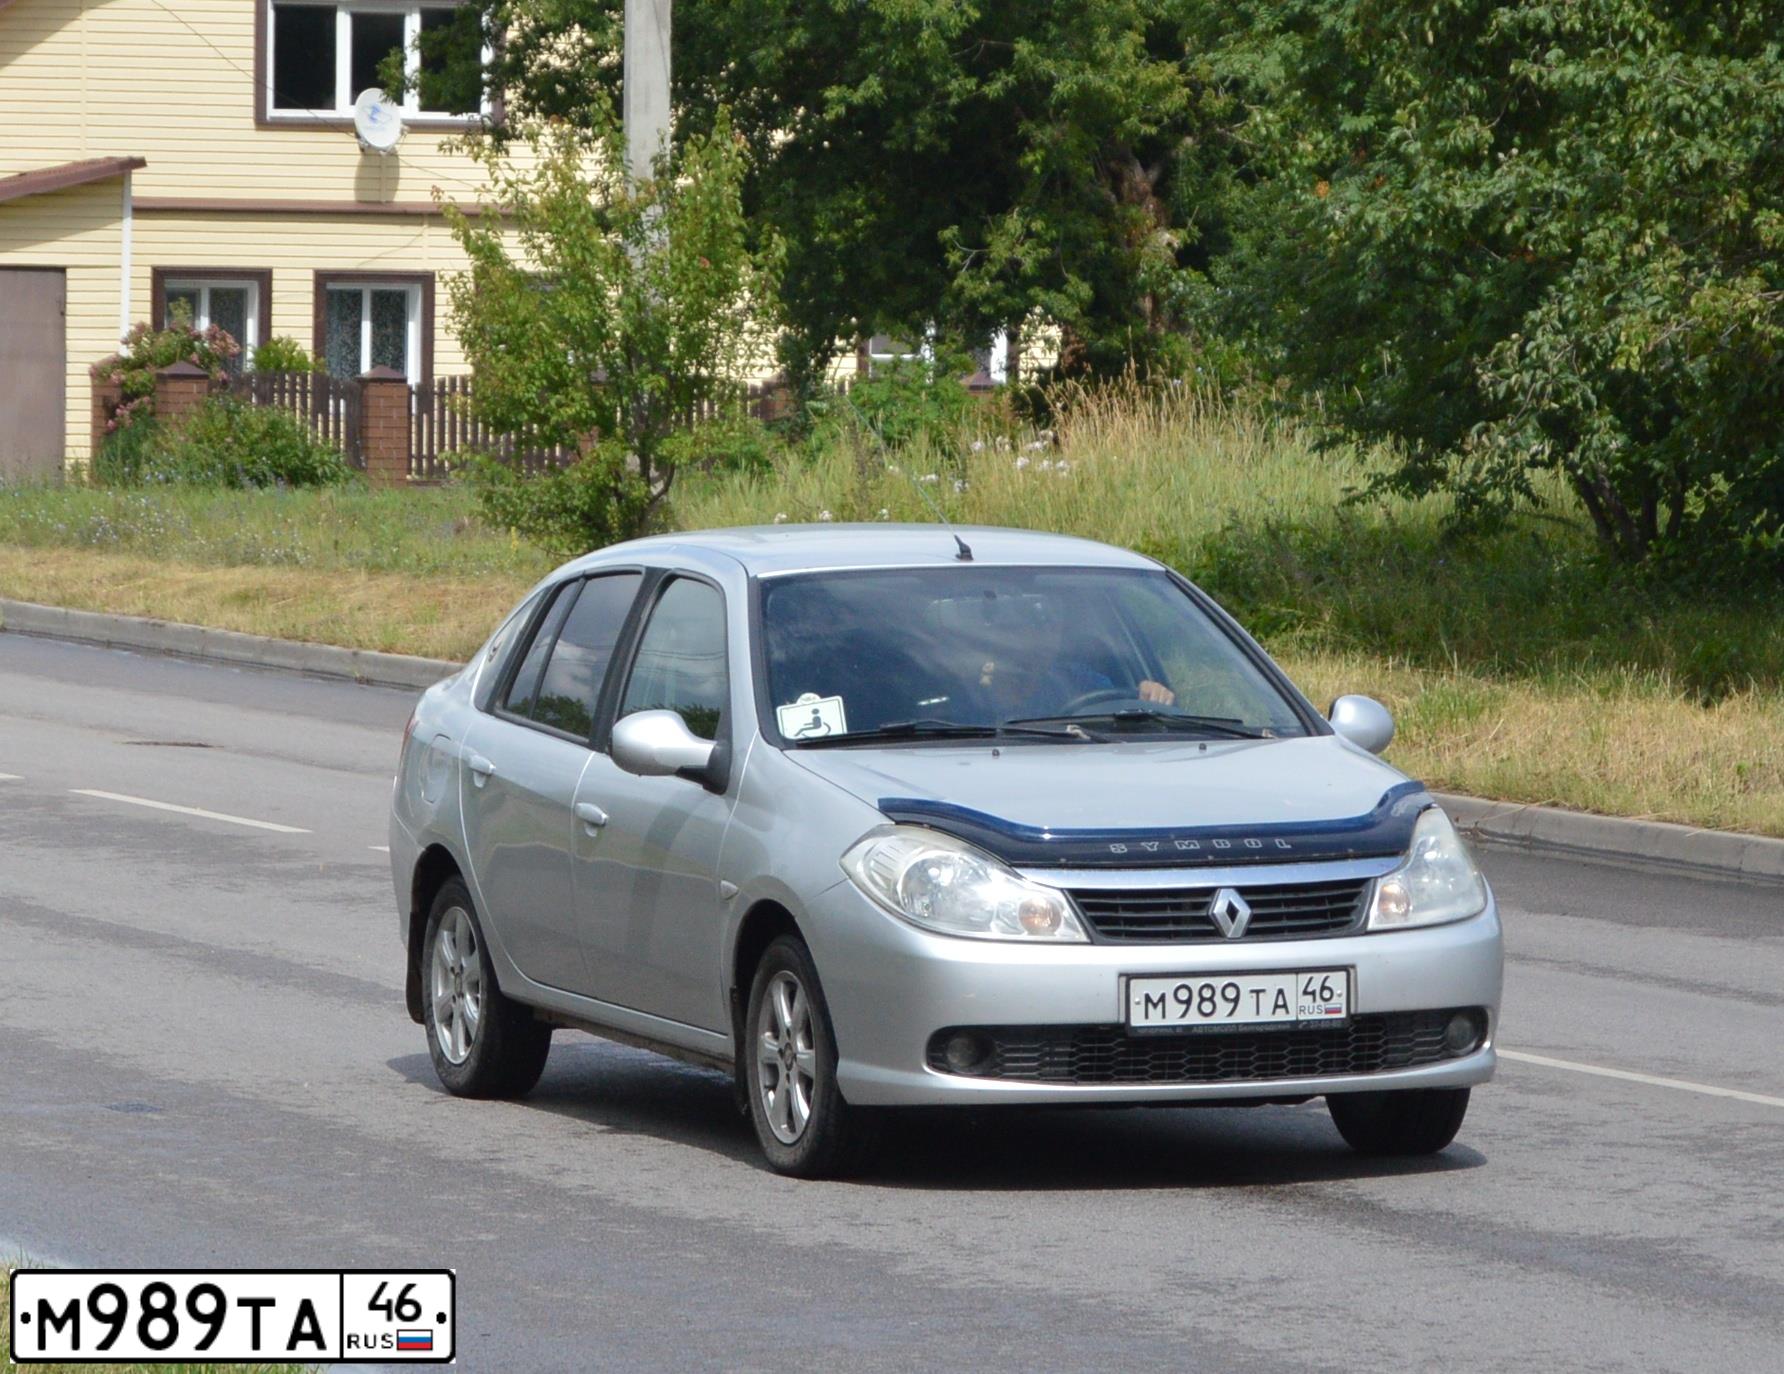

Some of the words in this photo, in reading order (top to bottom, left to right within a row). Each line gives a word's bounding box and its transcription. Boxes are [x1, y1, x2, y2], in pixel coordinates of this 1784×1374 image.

[1109, 838, 1292, 854] SYMBOL
[1301, 975, 1335, 1003] 46
[1298, 1004, 1324, 1015] RUS
